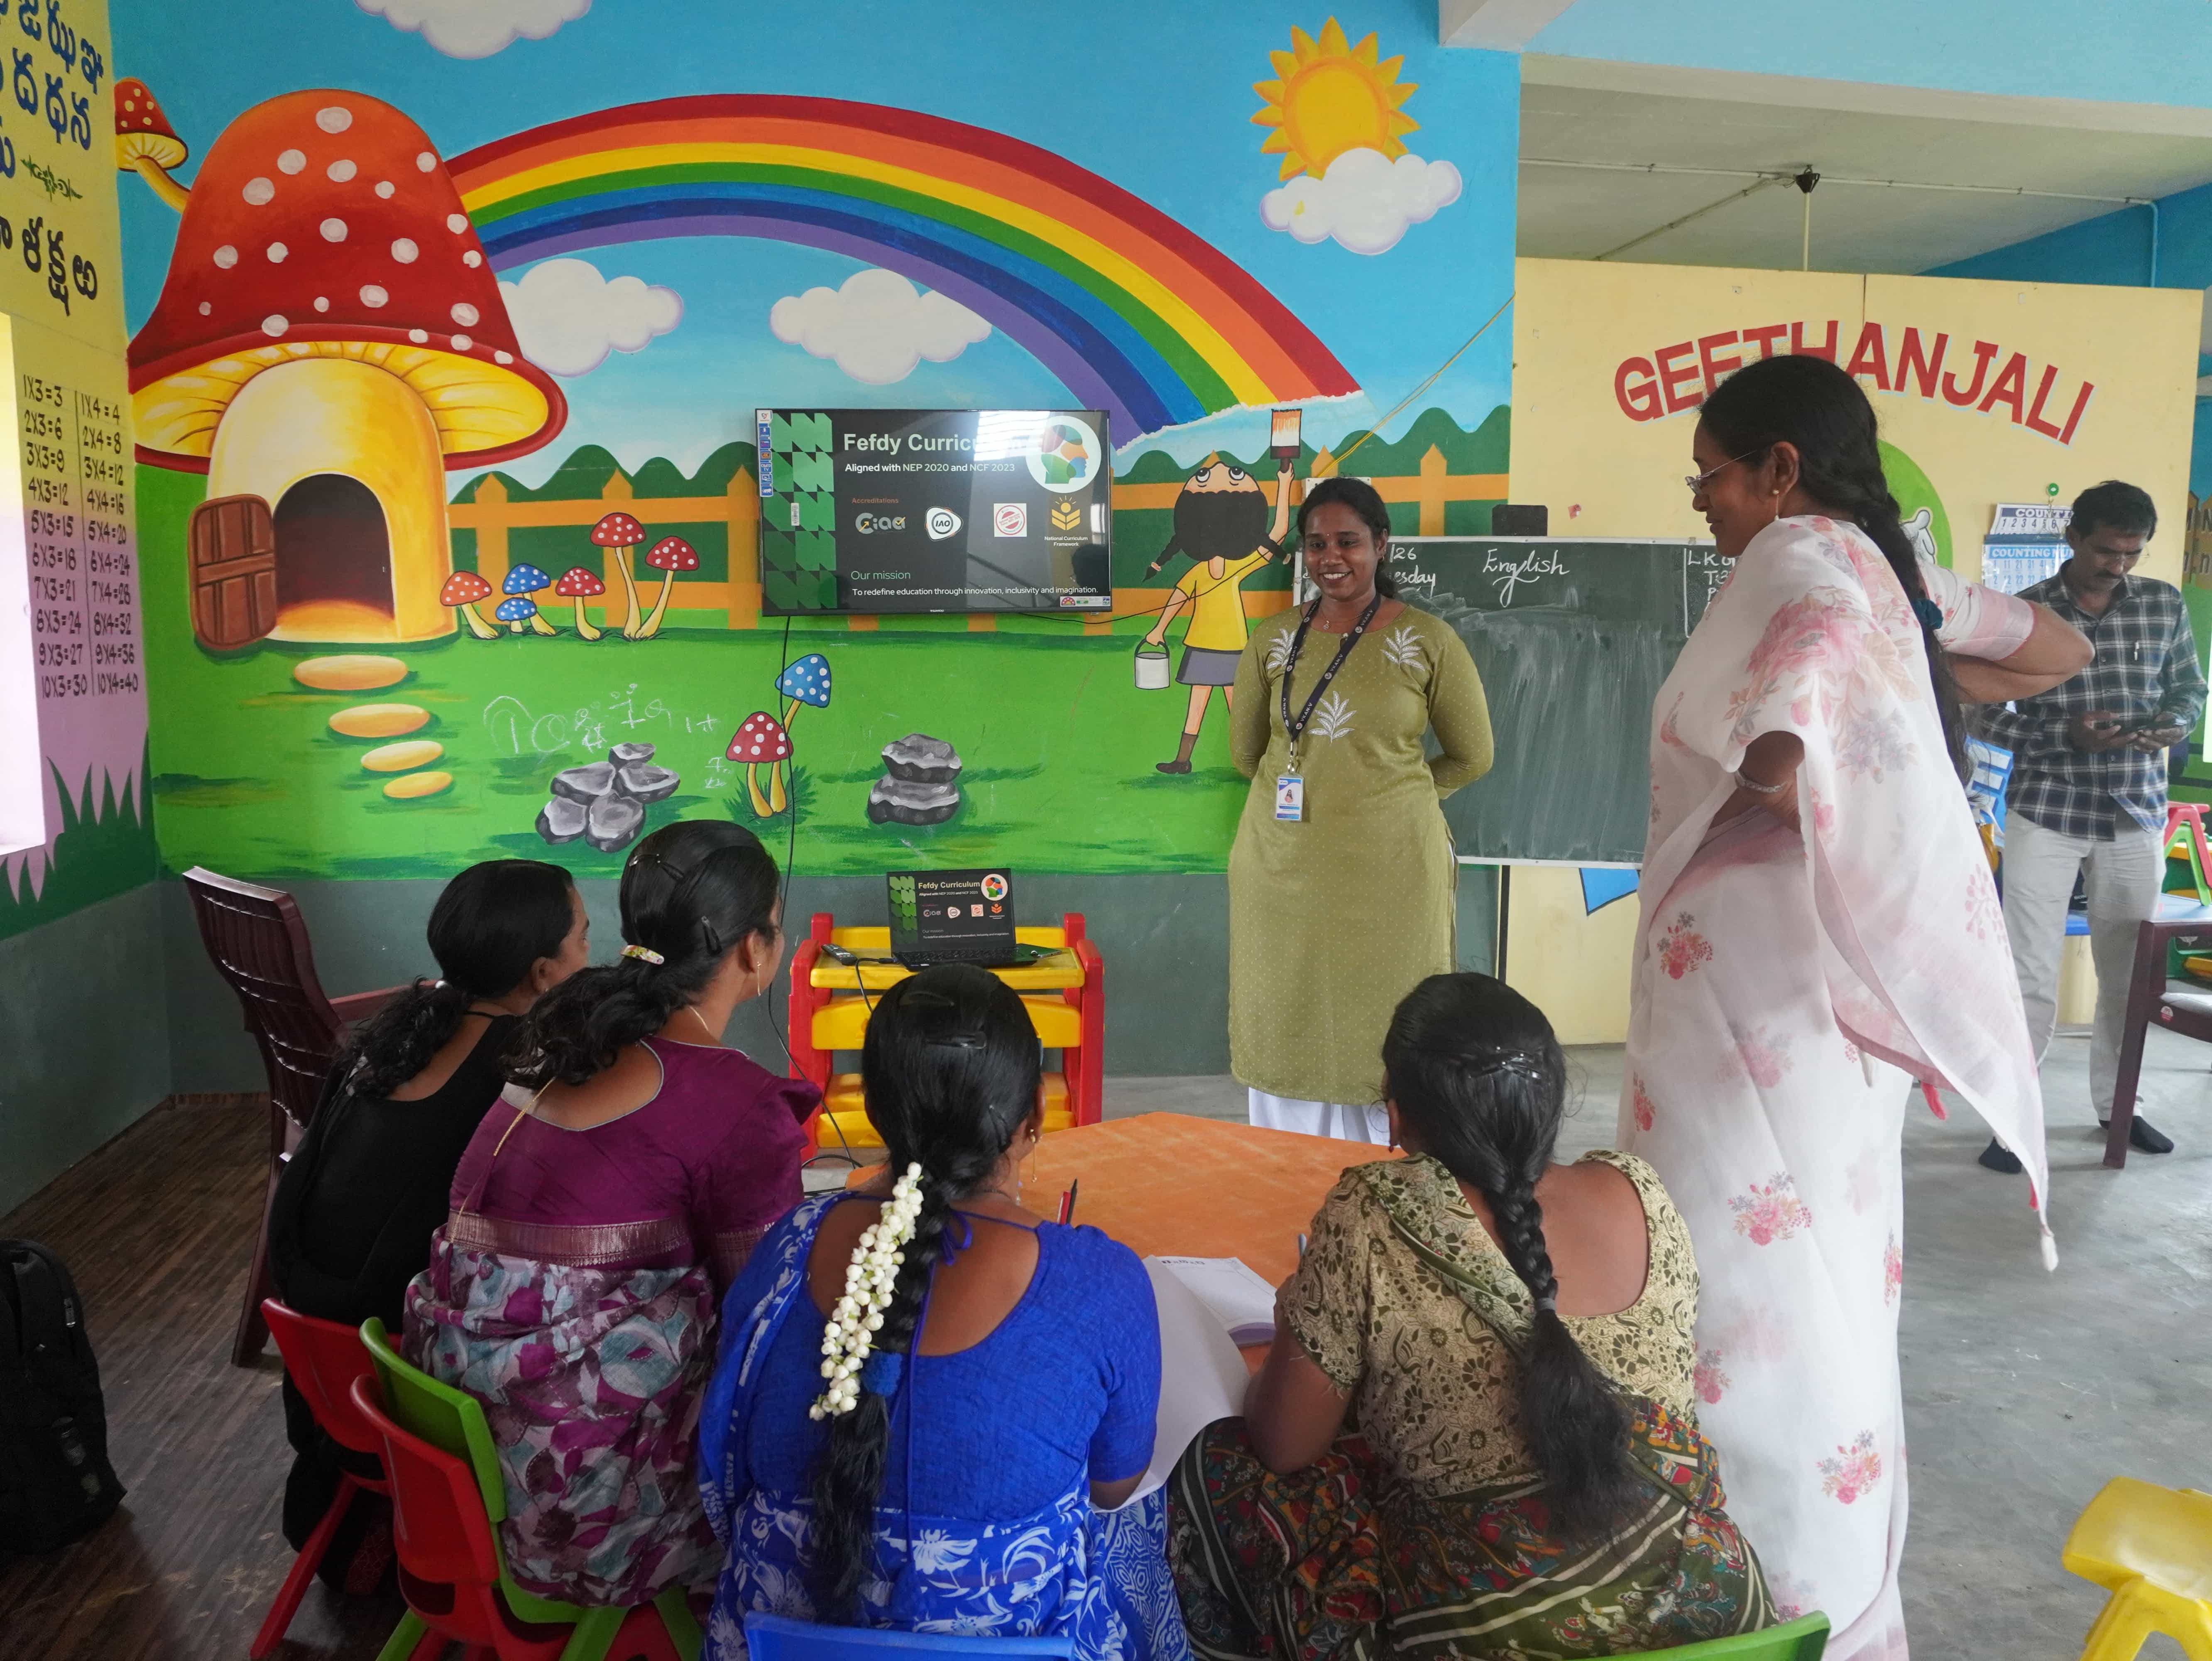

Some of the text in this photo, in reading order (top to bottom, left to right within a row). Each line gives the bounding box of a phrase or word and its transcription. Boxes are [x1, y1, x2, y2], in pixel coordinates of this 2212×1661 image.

[844, 434, 901, 455] Fefdy
[845, 464, 881, 473] Aligned
[1992, 548, 2051, 558] COUNTING
[851, 570, 910, 580] Our mission
[1483, 548, 1570, 608] English
[1393, 564, 1436, 599] esday
[1056, 586, 1098, 595] imagination.
